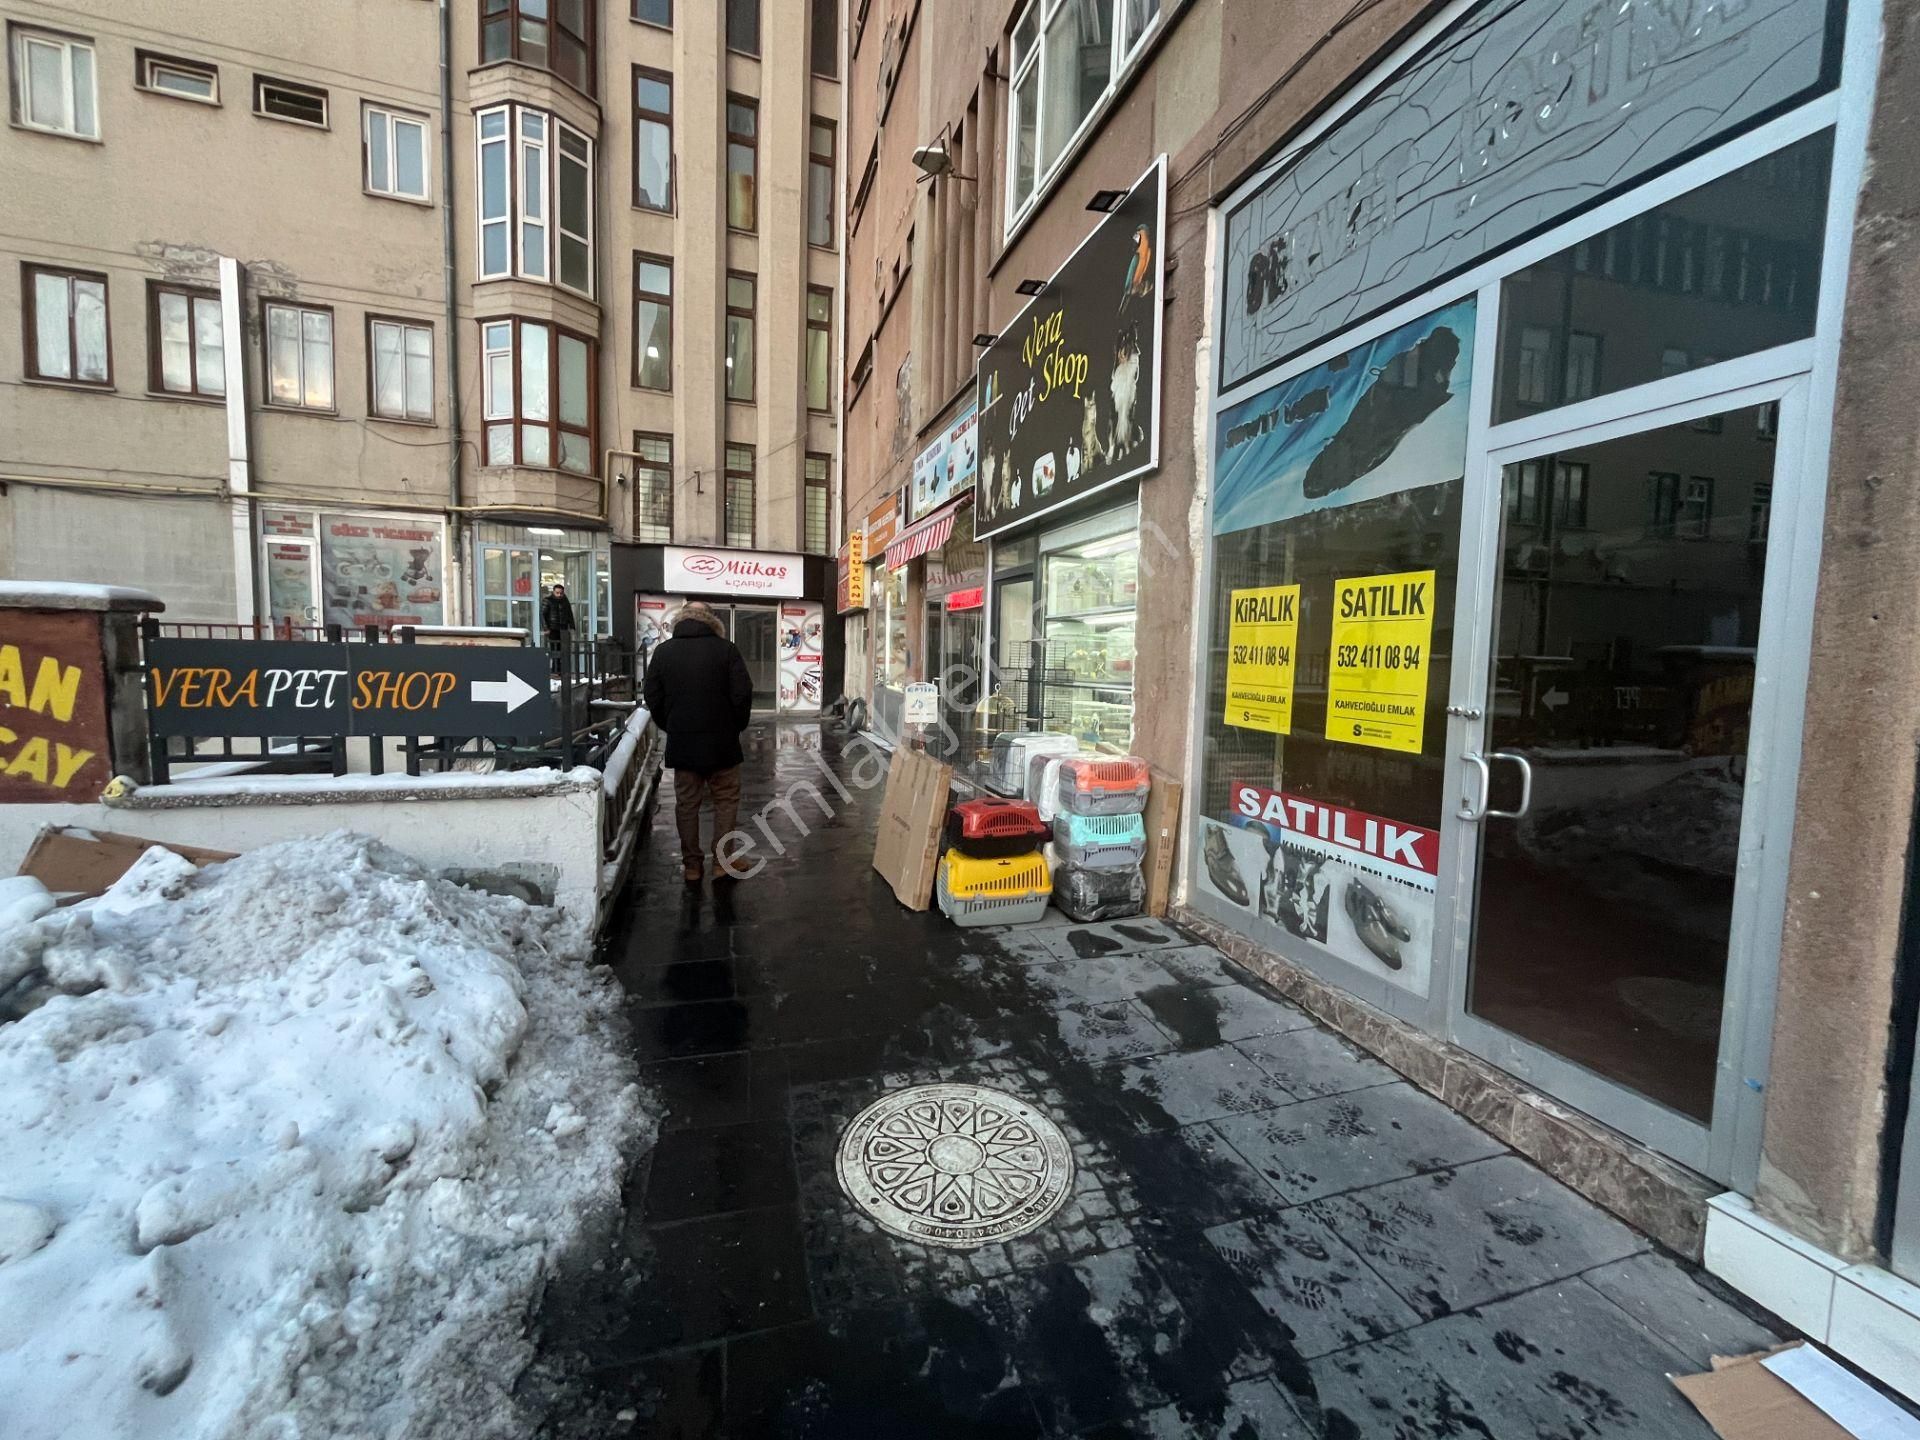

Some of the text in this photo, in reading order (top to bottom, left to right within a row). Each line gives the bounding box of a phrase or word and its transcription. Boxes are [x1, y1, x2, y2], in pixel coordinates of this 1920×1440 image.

[1022, 308, 1064, 368] Vera
[1009, 339, 1088, 441] Pet Shop
[725, 559, 788, 580] Mükaş
[851, 535, 863, 598] MESUTCAN
[1340, 582, 1426, 618] SATILIK
[1233, 645, 1290, 667] 532 411 08 94
[1337, 645, 1420, 670] 532 411 08 94
[351, 671, 457, 711] SHOP
[1335, 699, 1416, 716] KAHVECİOĞLU EMLAK
[1238, 787, 1425, 869] SATILIK
